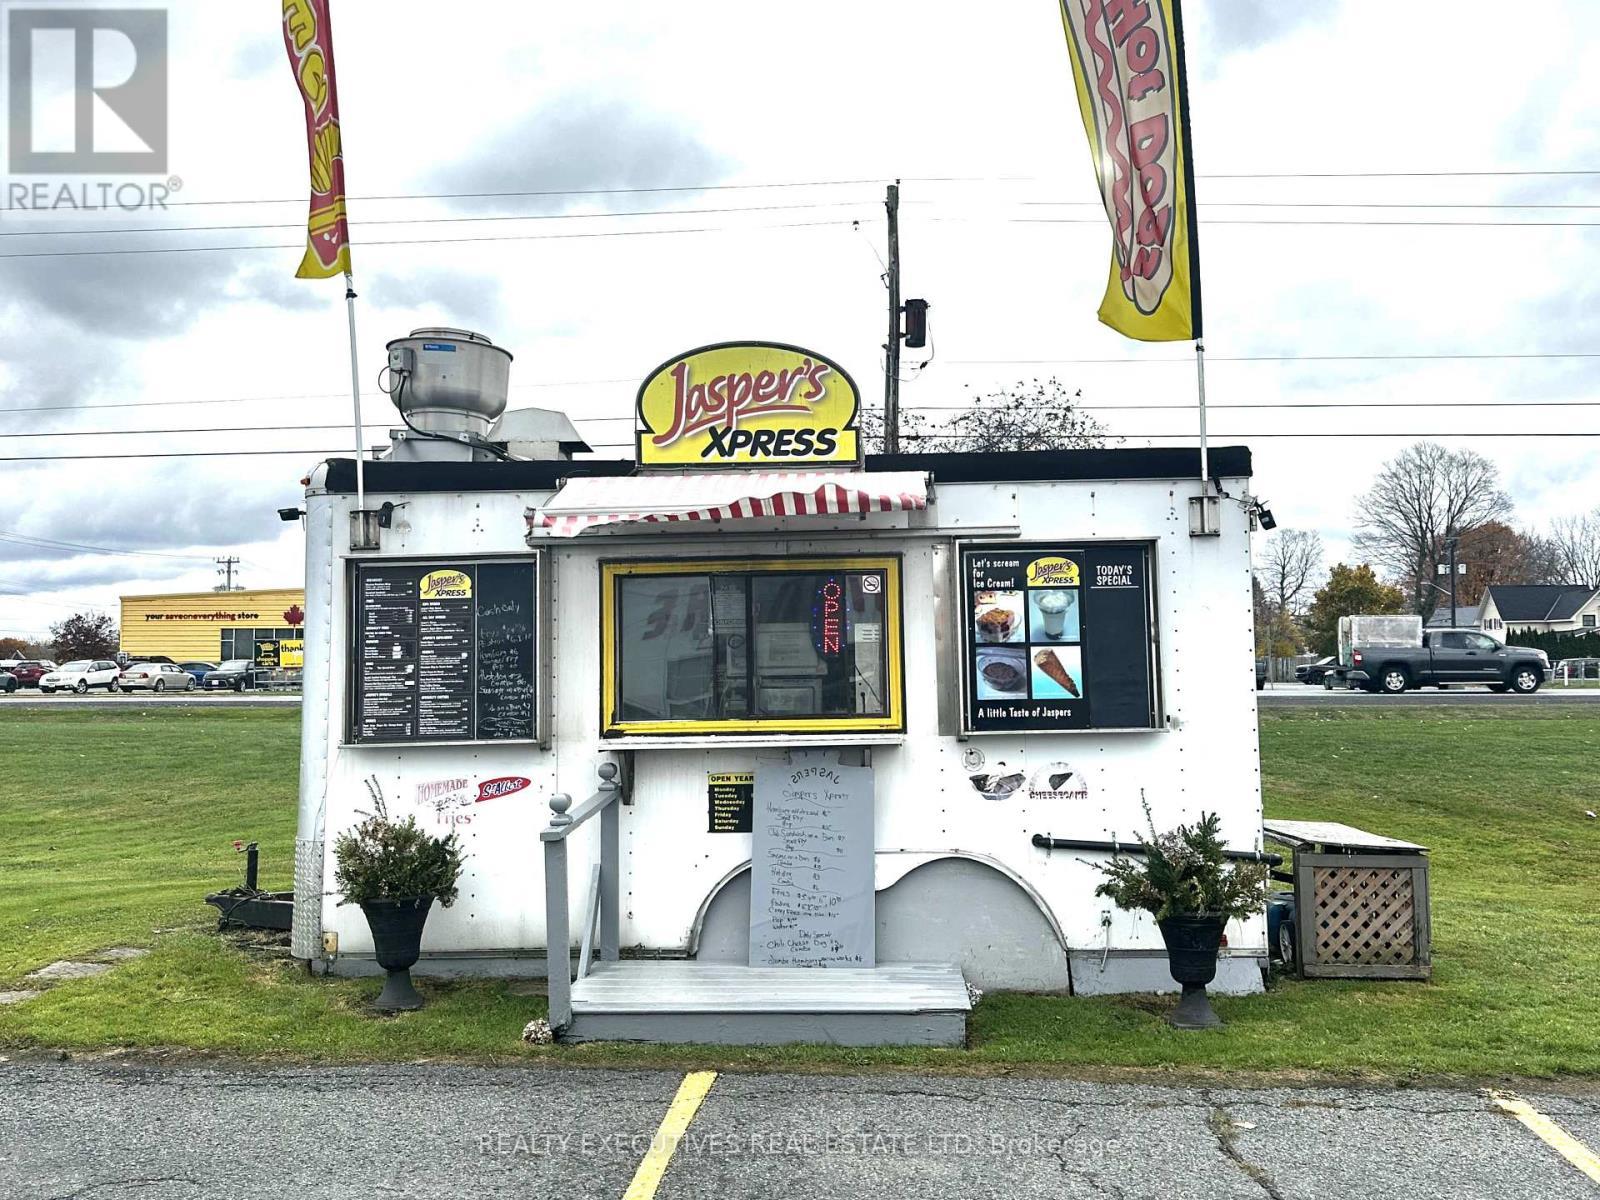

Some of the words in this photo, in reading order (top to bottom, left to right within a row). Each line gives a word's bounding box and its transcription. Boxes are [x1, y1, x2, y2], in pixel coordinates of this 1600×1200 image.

[652, 358, 831, 447] Jasper's
[701, 426, 838, 457] XPRESS
[972, 558, 991, 568] Let's
[993, 560, 1020, 568] scream
[972, 568, 985, 578] for
[1030, 562, 1073, 583] Jasper's
[1096, 565, 1133, 576] TODAY'S
[423, 574, 466, 596] Jasper's
[973, 578, 985, 588] Ice
[987, 577, 1015, 588] Cream!
[1042, 576, 1075, 584] XPRESS
[1096, 576, 1132, 586] SPECIAL
[435, 589, 467, 597] XPRESS
[145, 614, 164, 622] your
[823, 582, 842, 655] OPEN
[978, 708, 985, 718] A
[987, 707, 1007, 718] little
[1009, 707, 1029, 718] Taste
[1031, 707, 1040, 717] of
[1042, 706, 1072, 719] Jaspers
[416, 778, 469, 805] HOMEMADE
